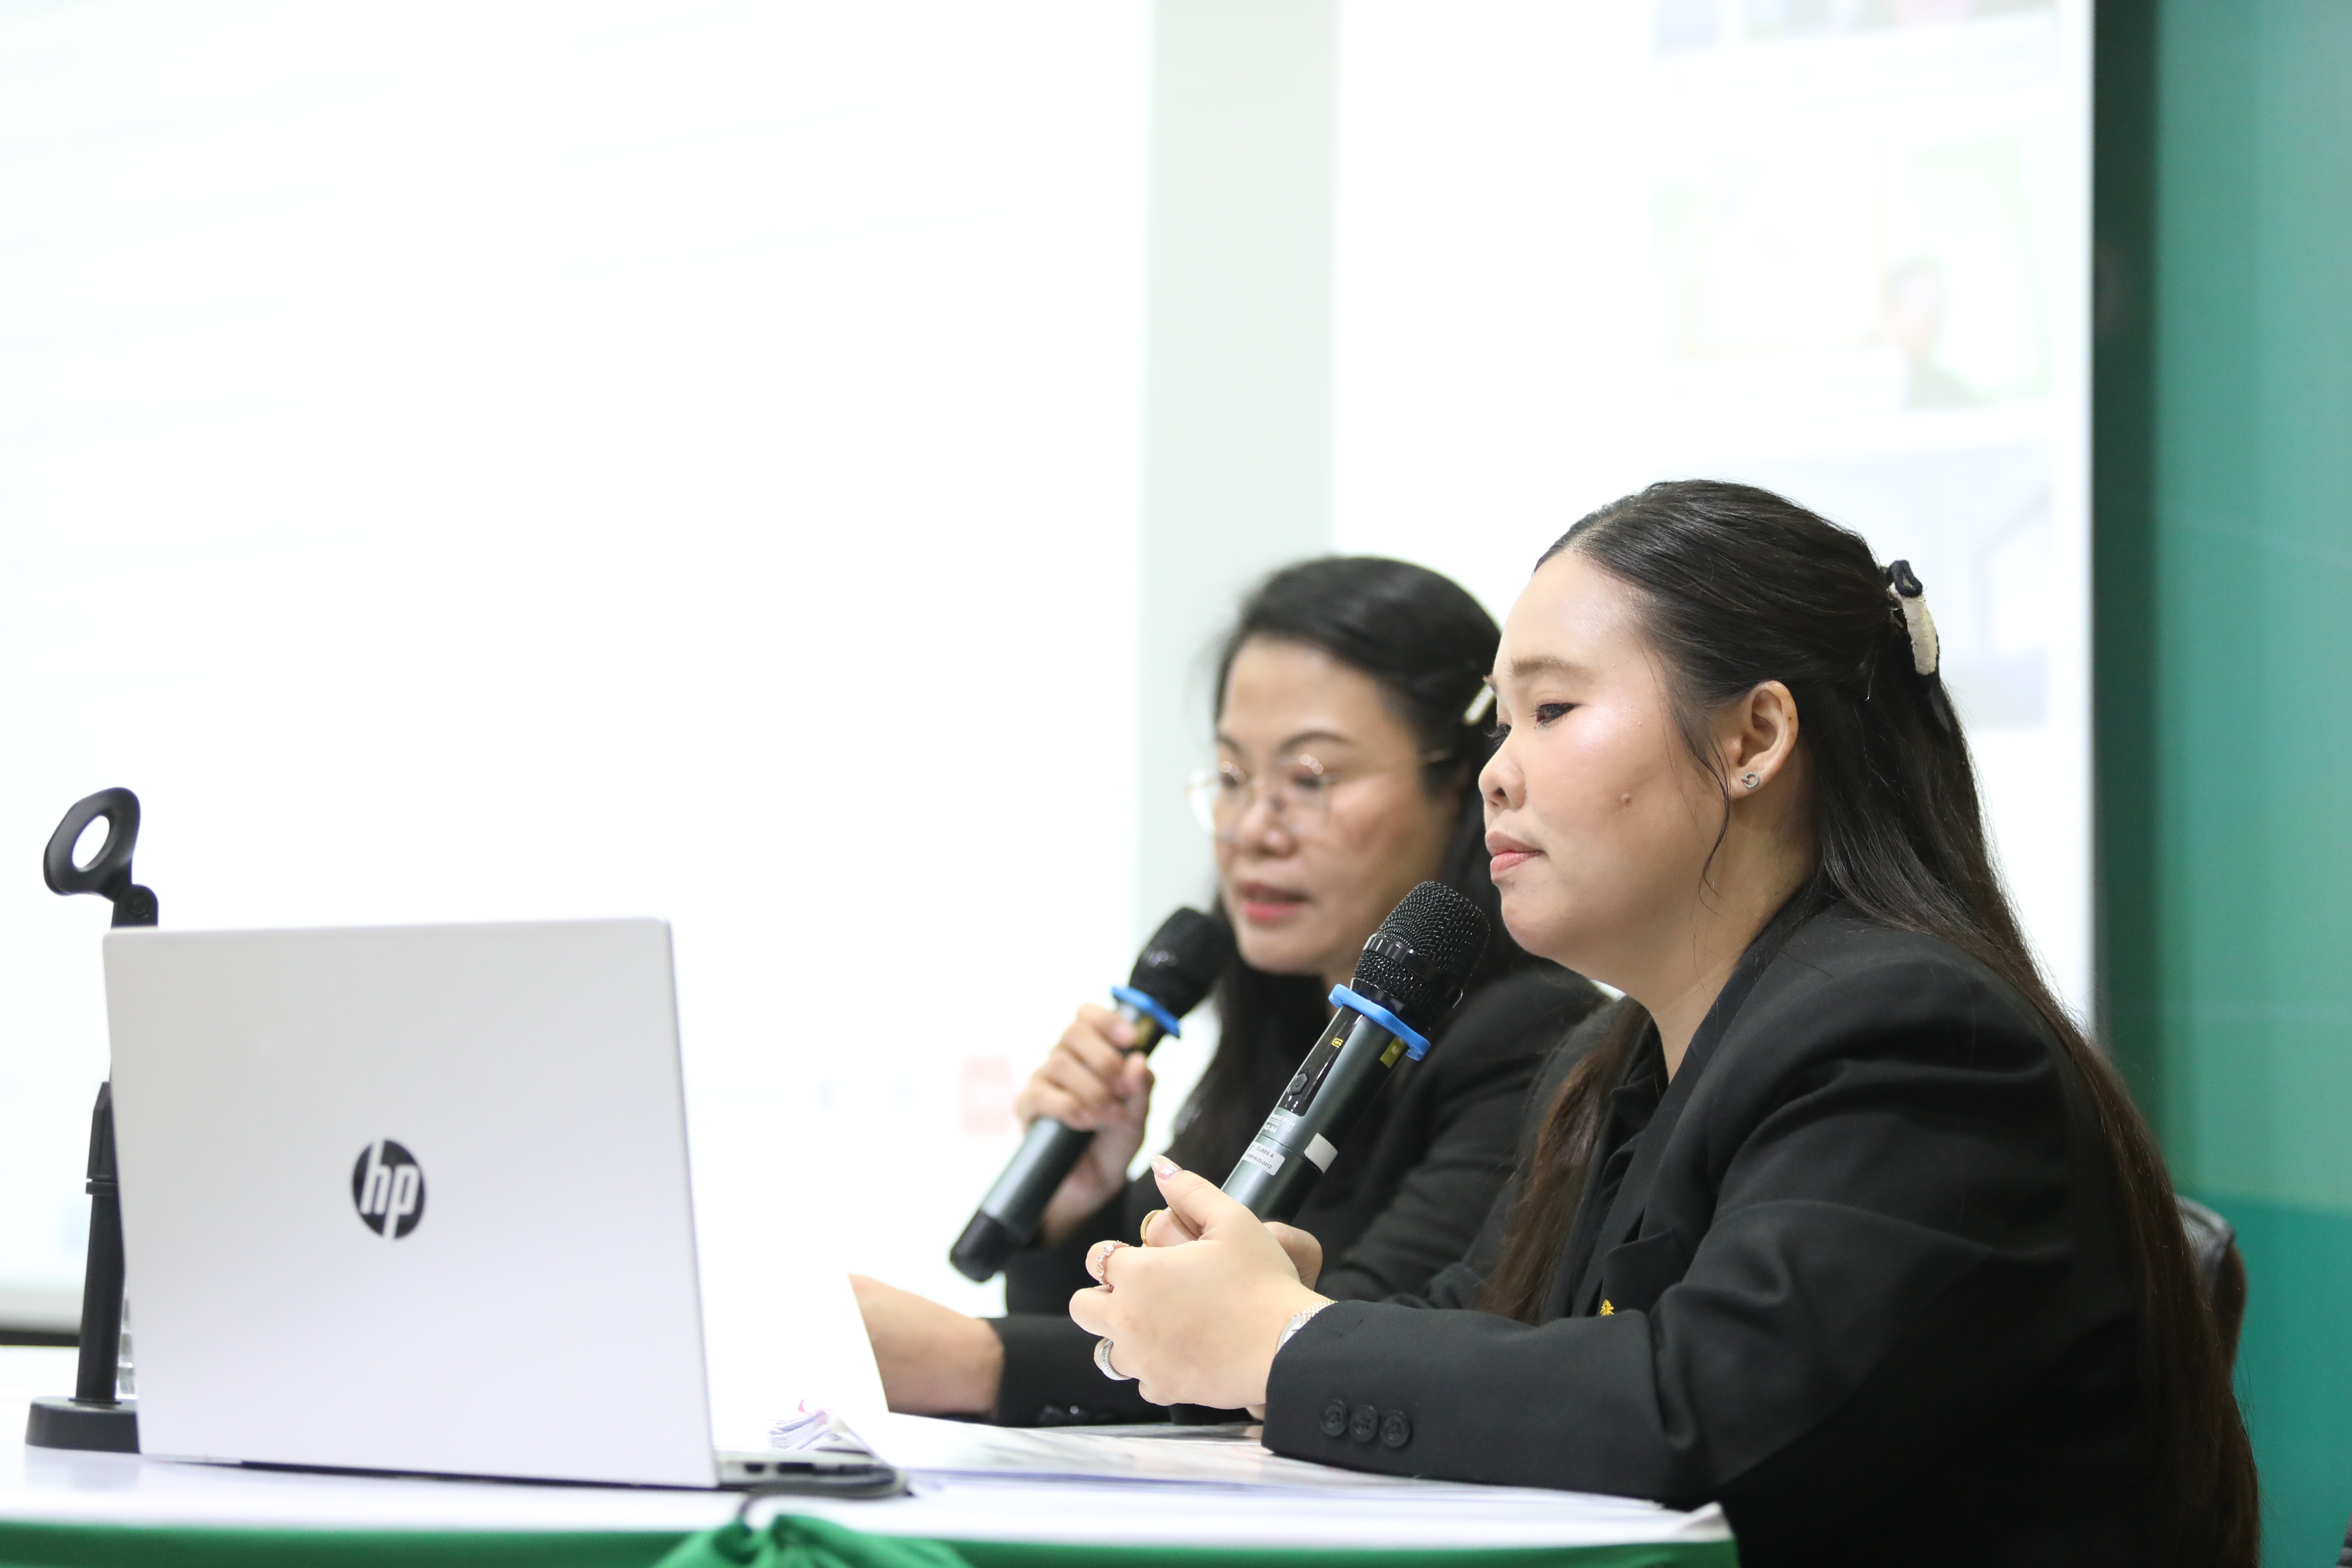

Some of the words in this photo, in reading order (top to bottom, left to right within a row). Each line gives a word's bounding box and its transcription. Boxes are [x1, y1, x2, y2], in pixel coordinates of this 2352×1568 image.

[1282, 1116, 1296, 1128] Best
[1256, 1146, 1270, 1155] CLASS
[359, 1138, 420, 1239] hp
